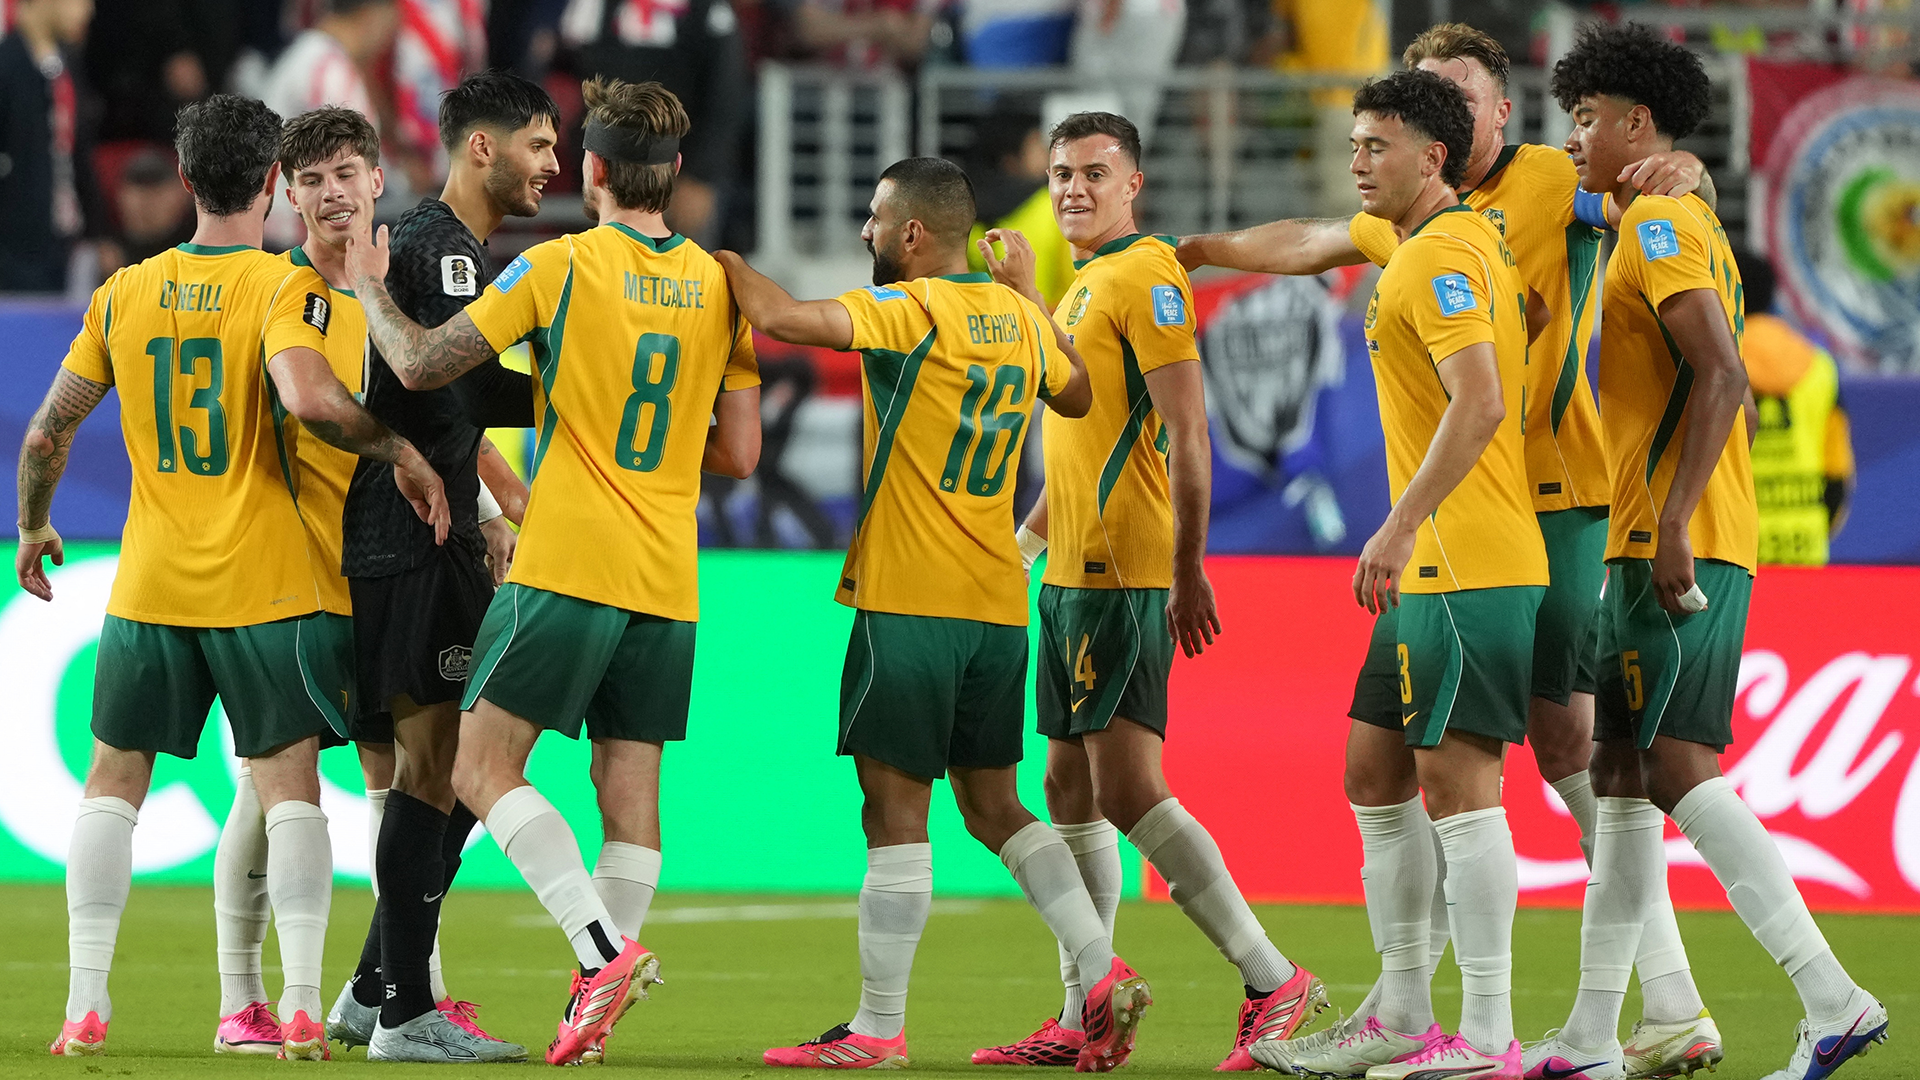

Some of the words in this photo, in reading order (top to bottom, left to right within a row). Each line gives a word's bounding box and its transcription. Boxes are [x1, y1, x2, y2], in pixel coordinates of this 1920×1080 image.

[624, 270, 704, 308] METCALFE
[145, 336, 230, 477] 13
[615, 332, 681, 473] 8
[939, 364, 1027, 497] 16
[1397, 643, 1412, 704] 3
[1622, 650, 1643, 711] 5
